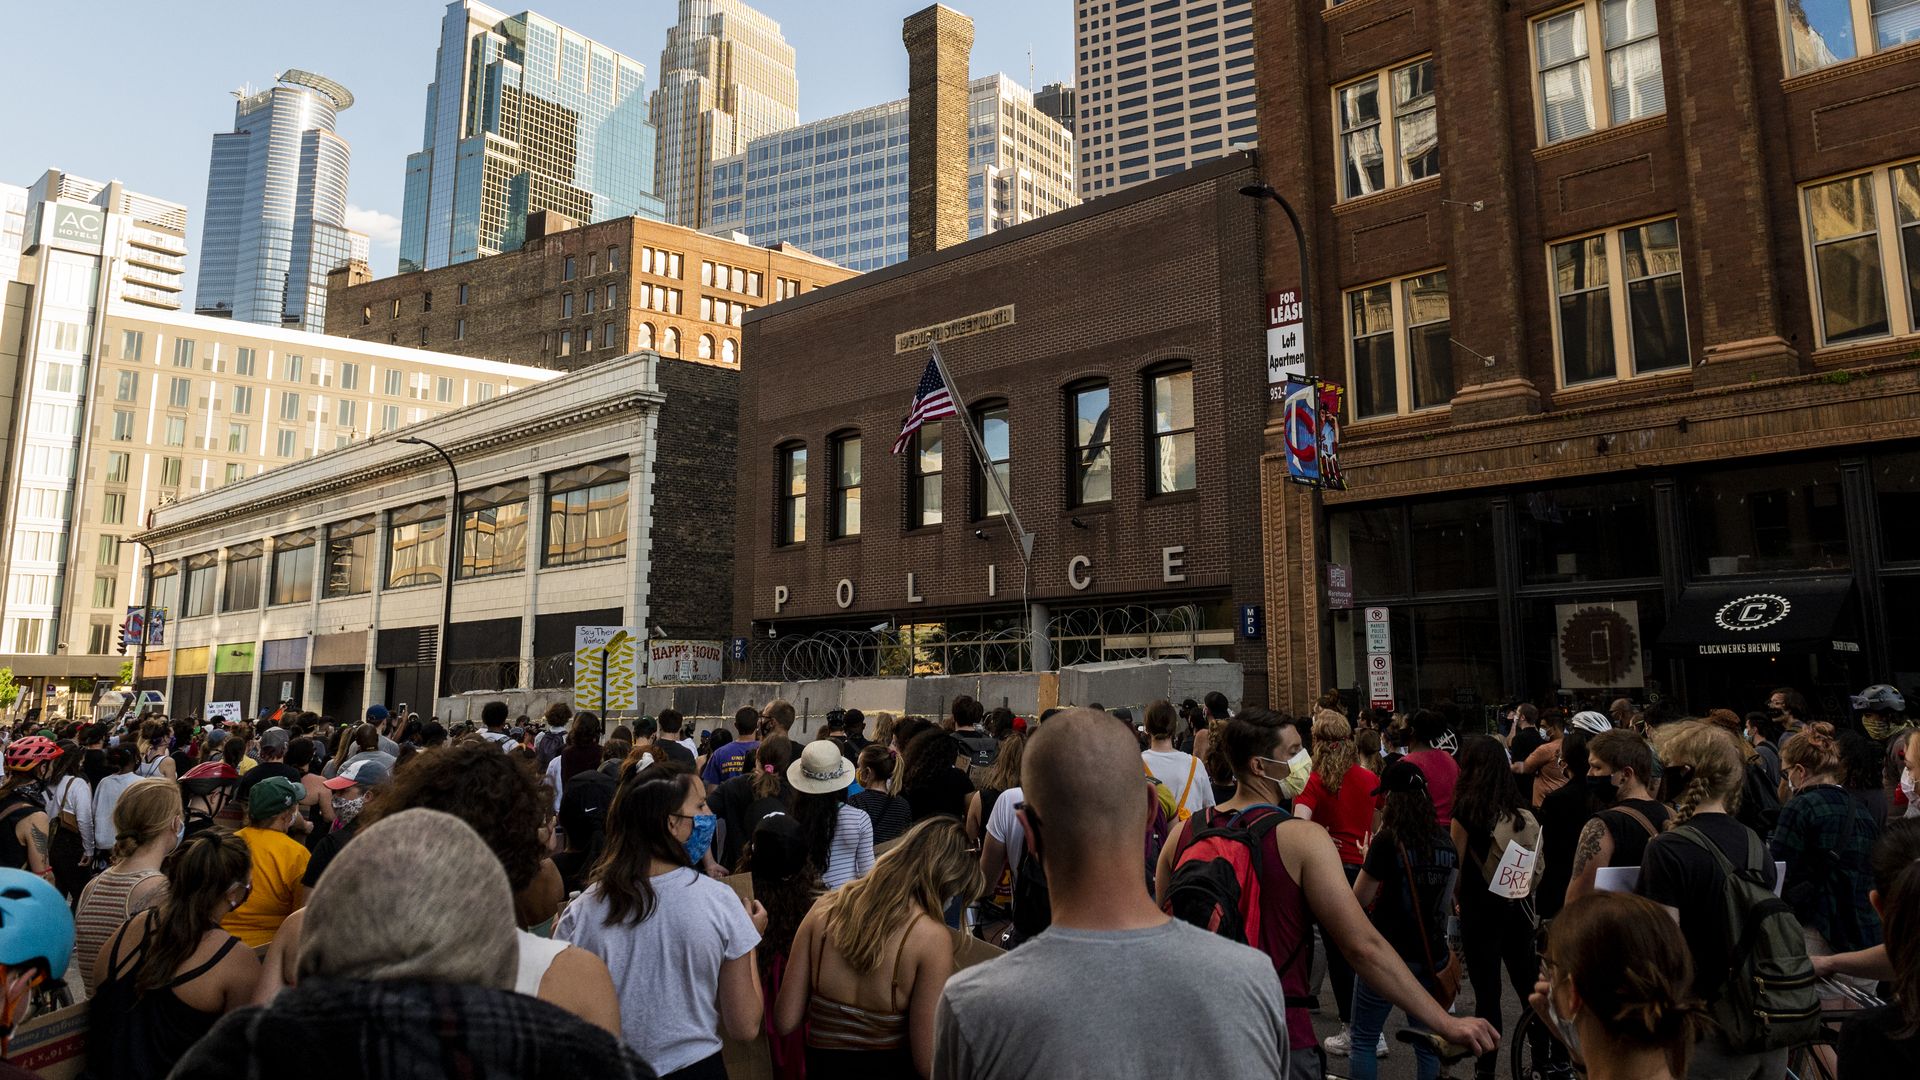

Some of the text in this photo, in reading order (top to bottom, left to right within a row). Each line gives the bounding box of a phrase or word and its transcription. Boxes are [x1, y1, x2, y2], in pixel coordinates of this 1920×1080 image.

[61, 212, 99, 232] AC
[59, 228, 98, 240] HOTELS
[1280, 291, 1295, 305] FOR
[944, 318, 977, 339] STREET
[978, 309, 1010, 330] NORTH
[1282, 332, 1296, 348] Loft
[1270, 353, 1304, 372] Apartmen
[1270, 385, 1288, 401] 952-4
[774, 545, 1186, 614] POLICE
[1331, 597, 1349, 605] District
[1247, 608, 1255, 634] MPD
[1738, 603, 1767, 622] C
[581, 626, 616, 639] Say Their
[584, 636, 606, 645] Names
[652, 645, 720, 662] HAPPY HOUR
[1699, 642, 1781, 655] CLOCKWERKS BREWING
[1511, 849, 1529, 868] I
[1499, 866, 1531, 889] BRE
